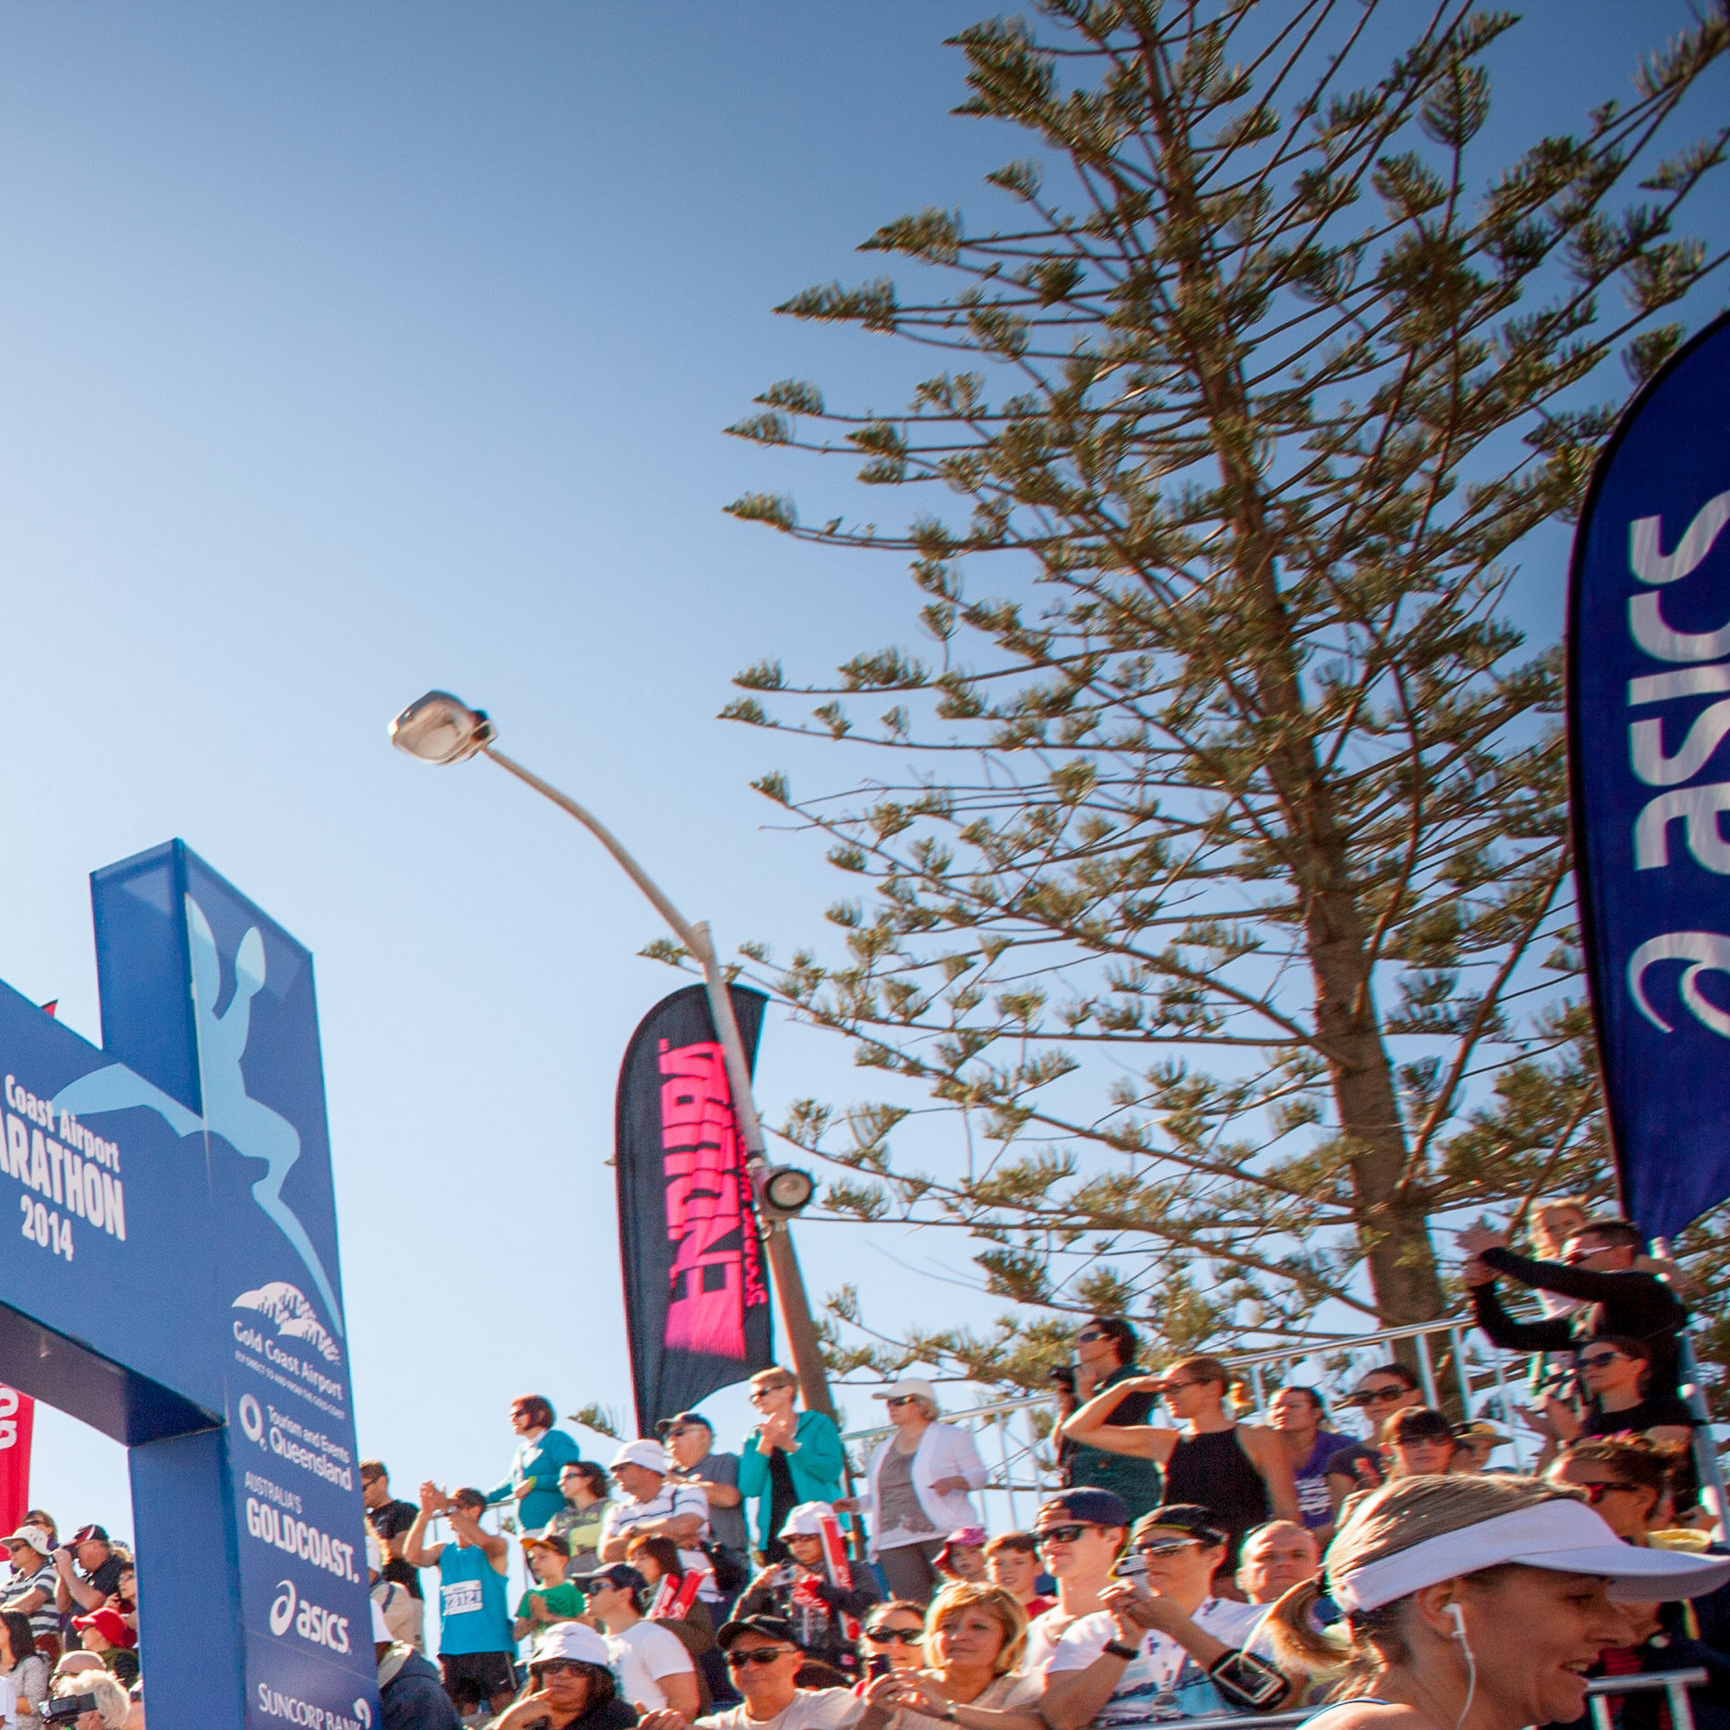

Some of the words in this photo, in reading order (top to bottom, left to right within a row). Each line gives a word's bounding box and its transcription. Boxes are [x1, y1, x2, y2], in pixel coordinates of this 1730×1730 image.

[5, 1074, 55, 1132] Coast
[60, 1109, 121, 1173] Airport
[21, 1195, 74, 1262] 2014
[233, 1321, 263, 1353] Gold
[265, 1340, 300, 1375] Coast
[301, 1362, 344, 1400] Airport
[269, 1426, 353, 1492] Queensland
[258, 1682, 325, 1730] SUNCORP
